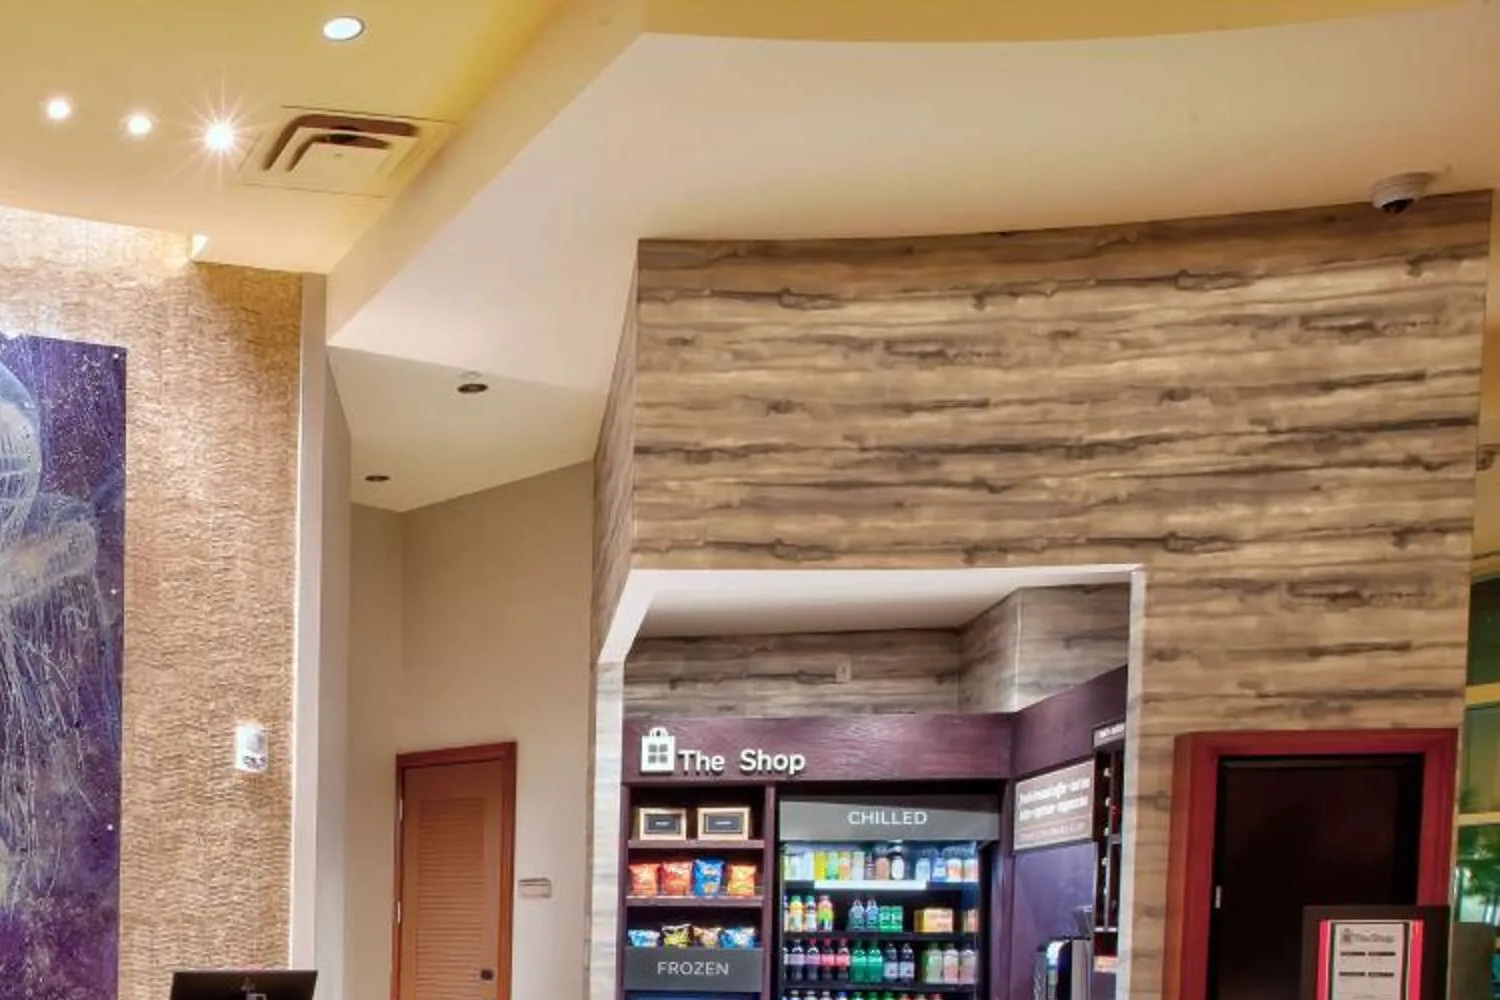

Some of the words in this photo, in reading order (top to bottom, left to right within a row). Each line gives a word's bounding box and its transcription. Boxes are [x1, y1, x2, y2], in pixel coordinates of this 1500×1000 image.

[677, 749, 725, 771] The
[740, 748, 806, 774] Shop
[847, 811, 928, 825] CHILLED
[657, 961, 729, 976] FROZEN
